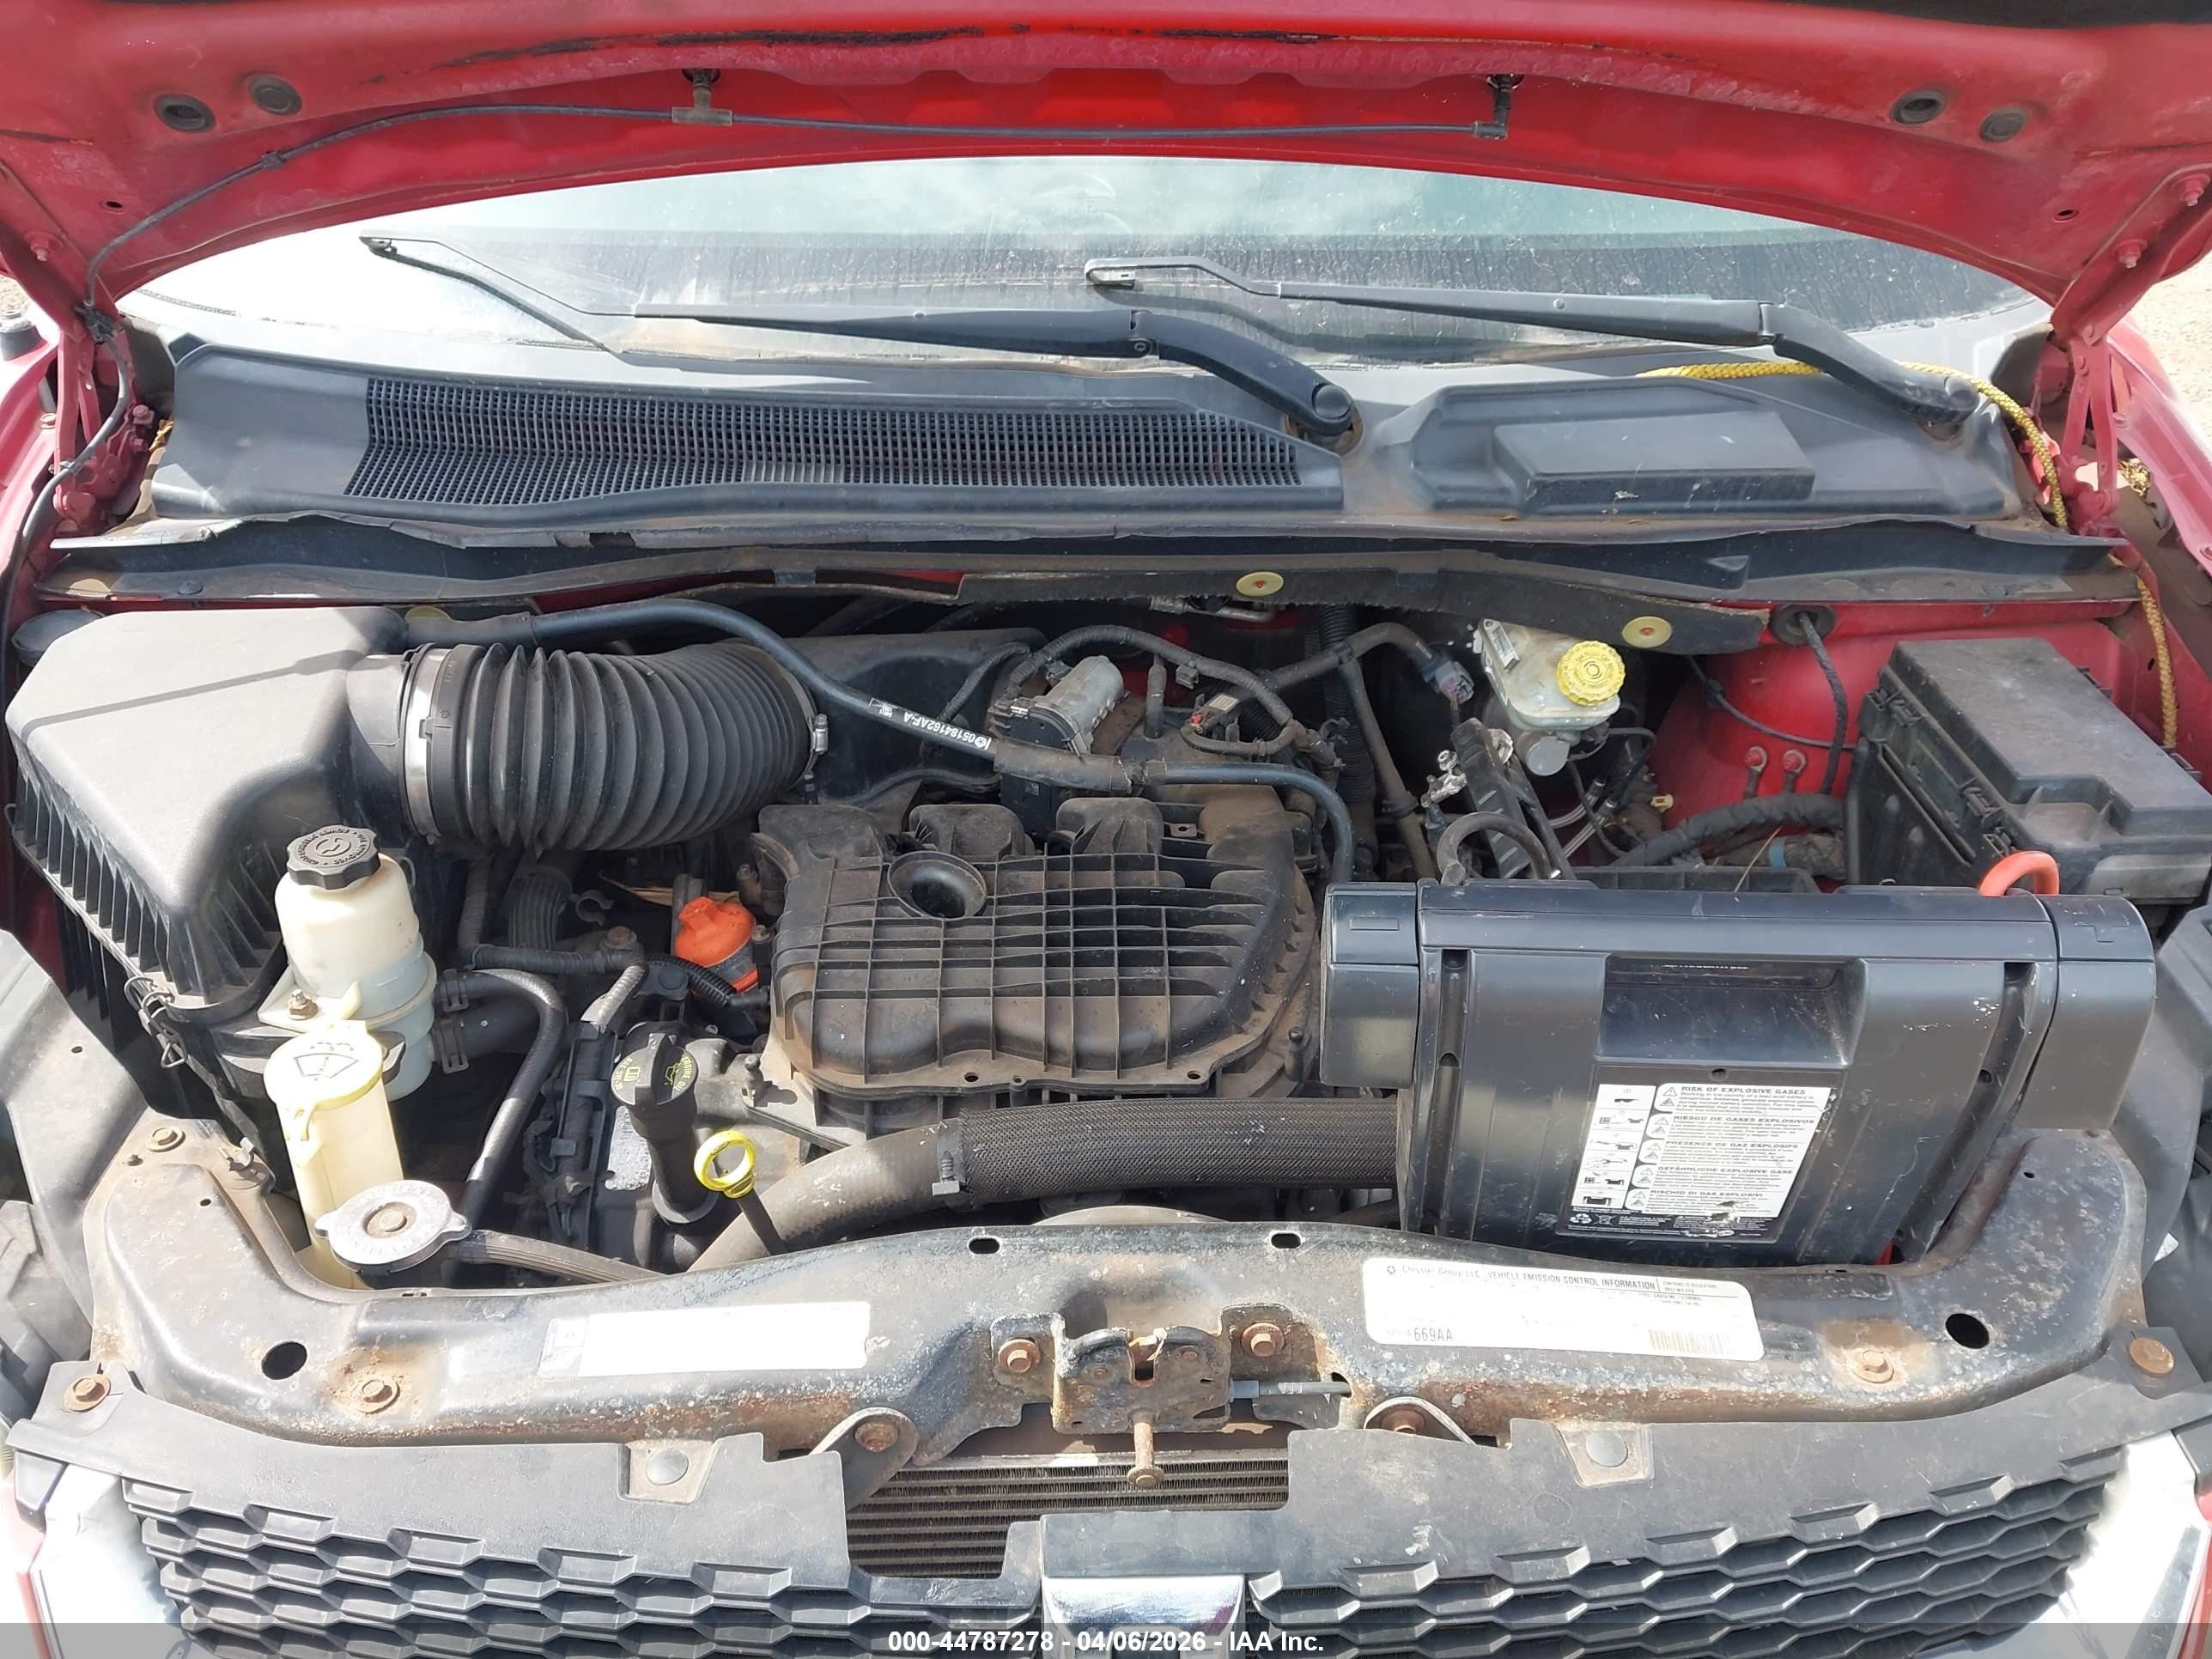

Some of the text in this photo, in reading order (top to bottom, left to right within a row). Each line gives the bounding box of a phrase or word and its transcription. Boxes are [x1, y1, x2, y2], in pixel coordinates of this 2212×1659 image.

[674, 1056, 695, 1091] ENGINE OIL
[1488, 1271, 1520, 1280] VEHICLE
[1522, 1273, 1561, 1284] EMISSION
[1564, 1276, 1599, 1286] CONTROL
[1601, 1278, 1656, 1290] INFORMATION
[1413, 1328, 1453, 1341] 669AA
